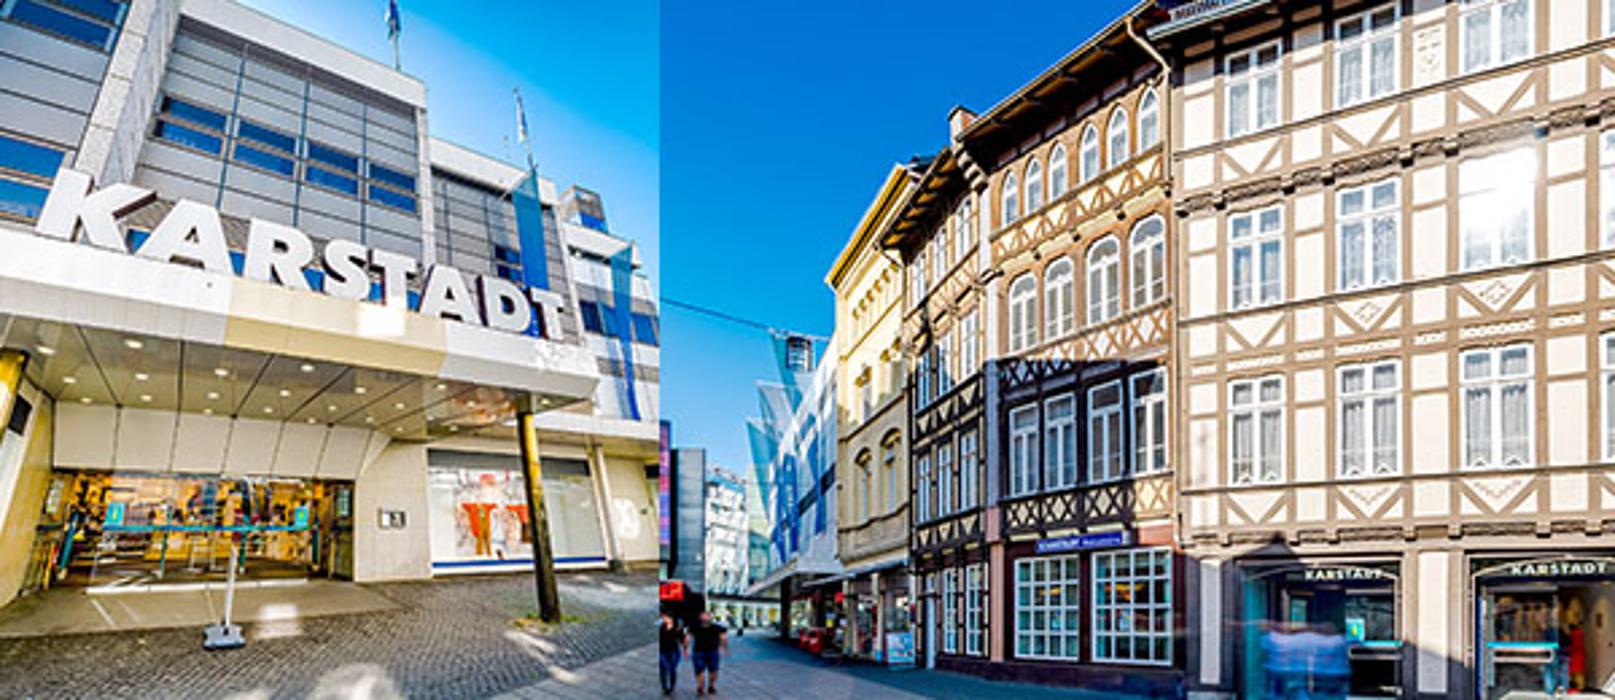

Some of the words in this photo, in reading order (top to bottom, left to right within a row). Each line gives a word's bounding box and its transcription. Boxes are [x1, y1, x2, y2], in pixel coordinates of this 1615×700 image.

[36, 168, 565, 339] KARSTADT
[1305, 569, 1382, 580] KARSTADT
[1511, 562, 1607, 575] KARSTADT
